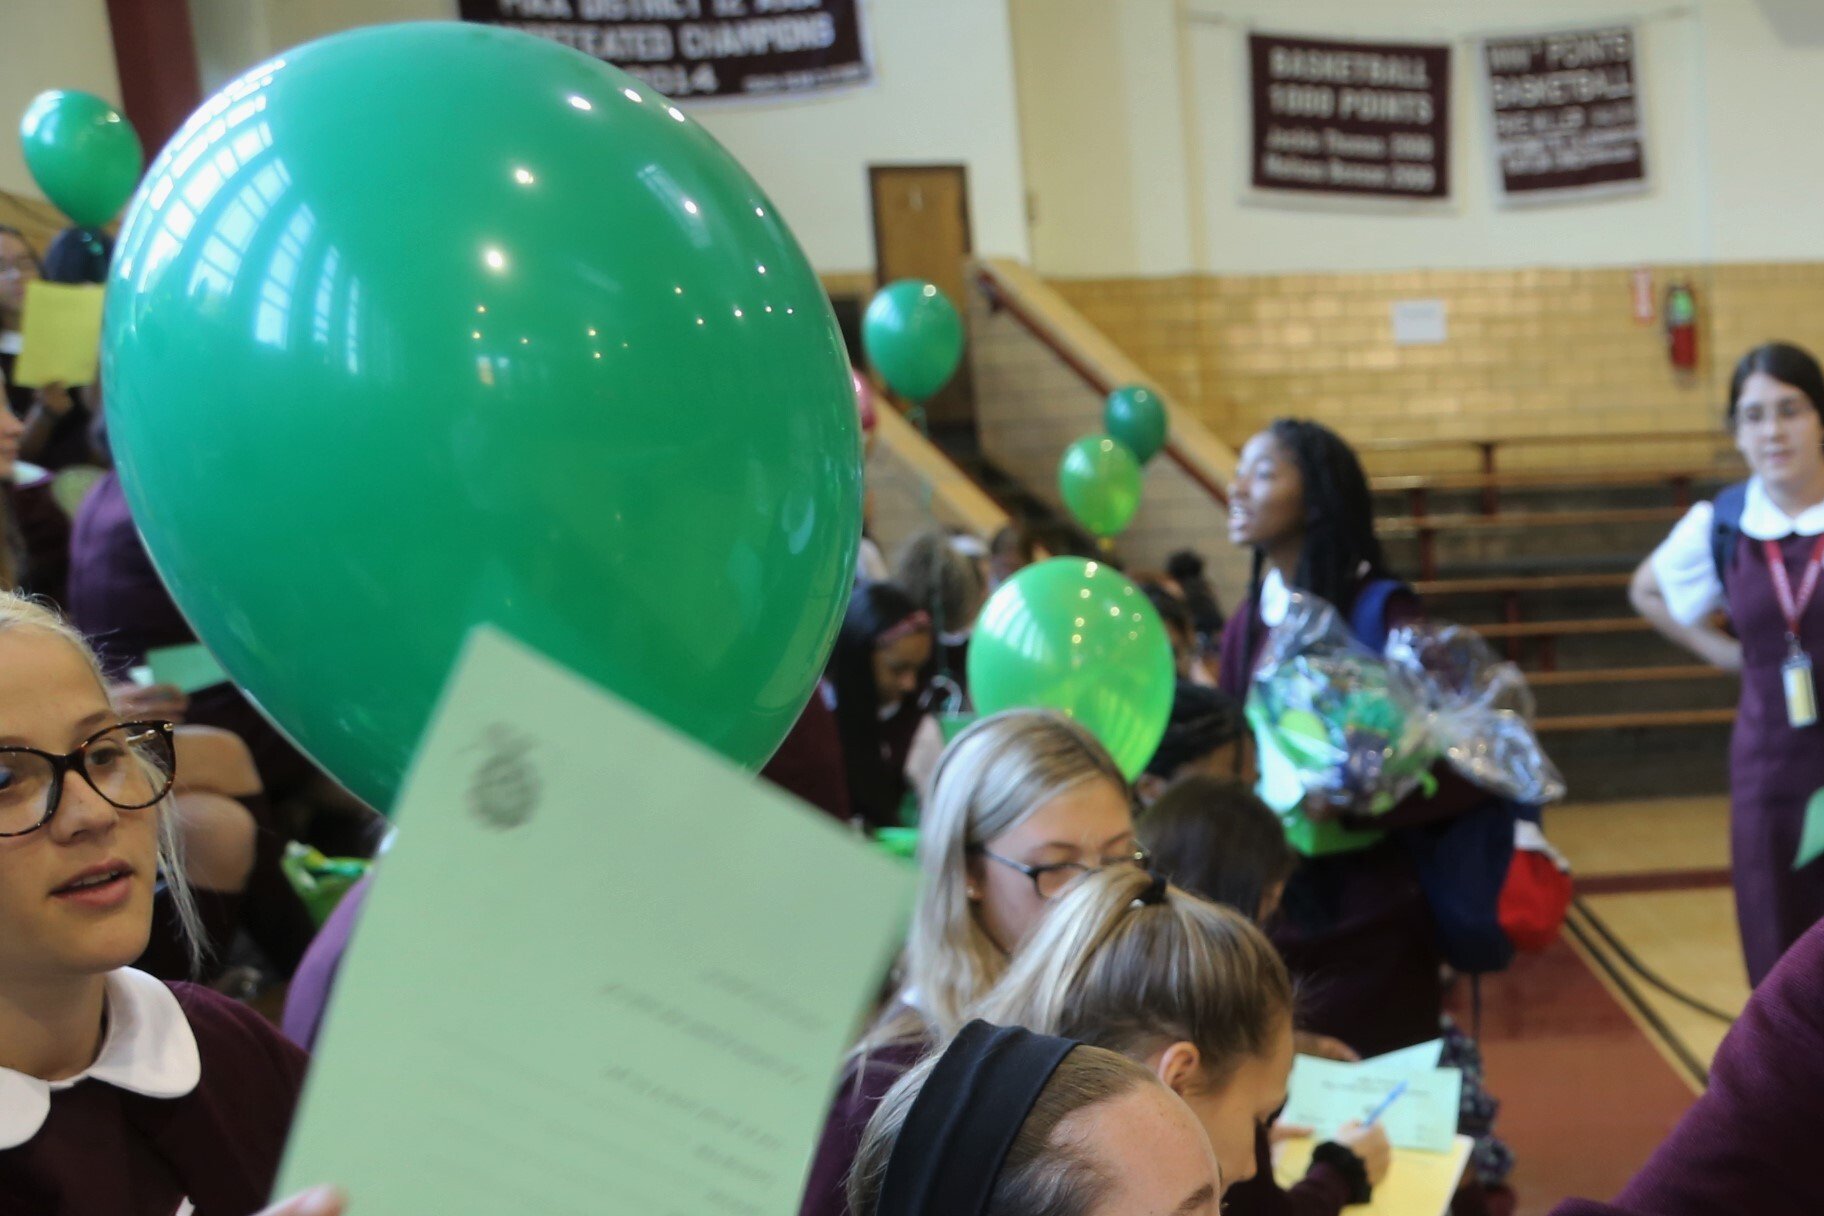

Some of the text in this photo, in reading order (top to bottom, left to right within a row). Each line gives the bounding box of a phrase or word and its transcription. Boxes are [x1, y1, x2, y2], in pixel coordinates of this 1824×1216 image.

[678, 11, 836, 60] CHAMPIONS
[1268, 45, 1431, 90] BASKETBALL
[1338, 87, 1435, 126] POINTS
